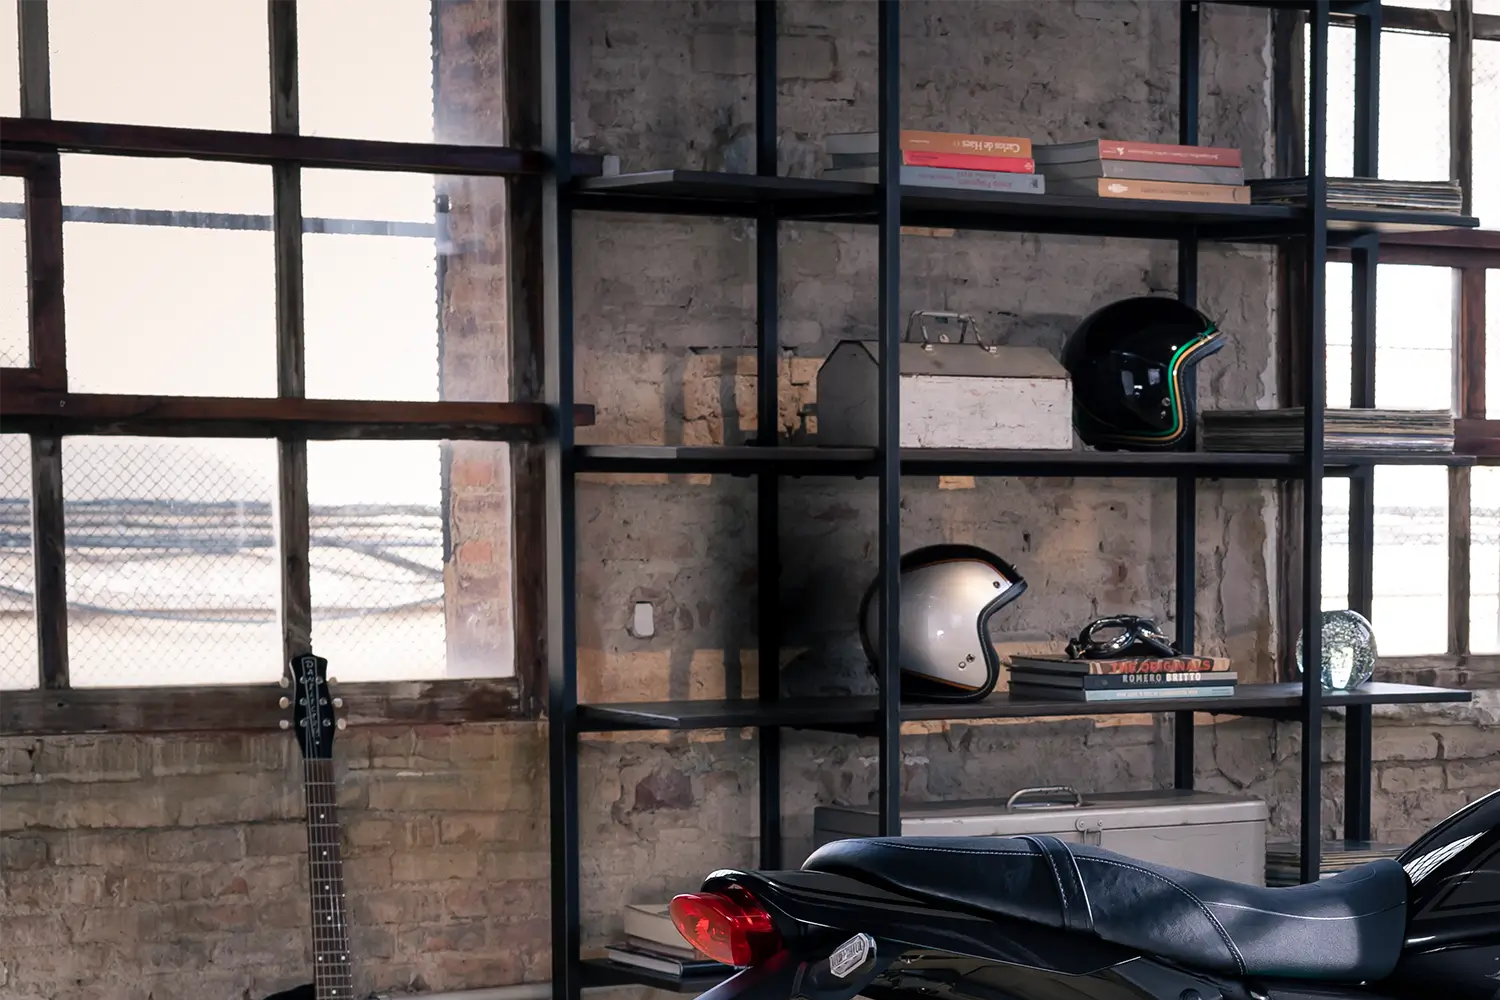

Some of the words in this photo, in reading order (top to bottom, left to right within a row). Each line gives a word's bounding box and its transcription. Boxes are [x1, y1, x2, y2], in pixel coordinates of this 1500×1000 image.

[962, 139, 983, 150] Haes
[983, 141, 994, 152] de
[994, 142, 1020, 153] Carlos
[1110, 661, 1137, 673] THE
[1138, 660, 1211, 672] ORIGINALS
[1122, 673, 1162, 683] ROMERO
[1165, 672, 1202, 682] BRITTO
